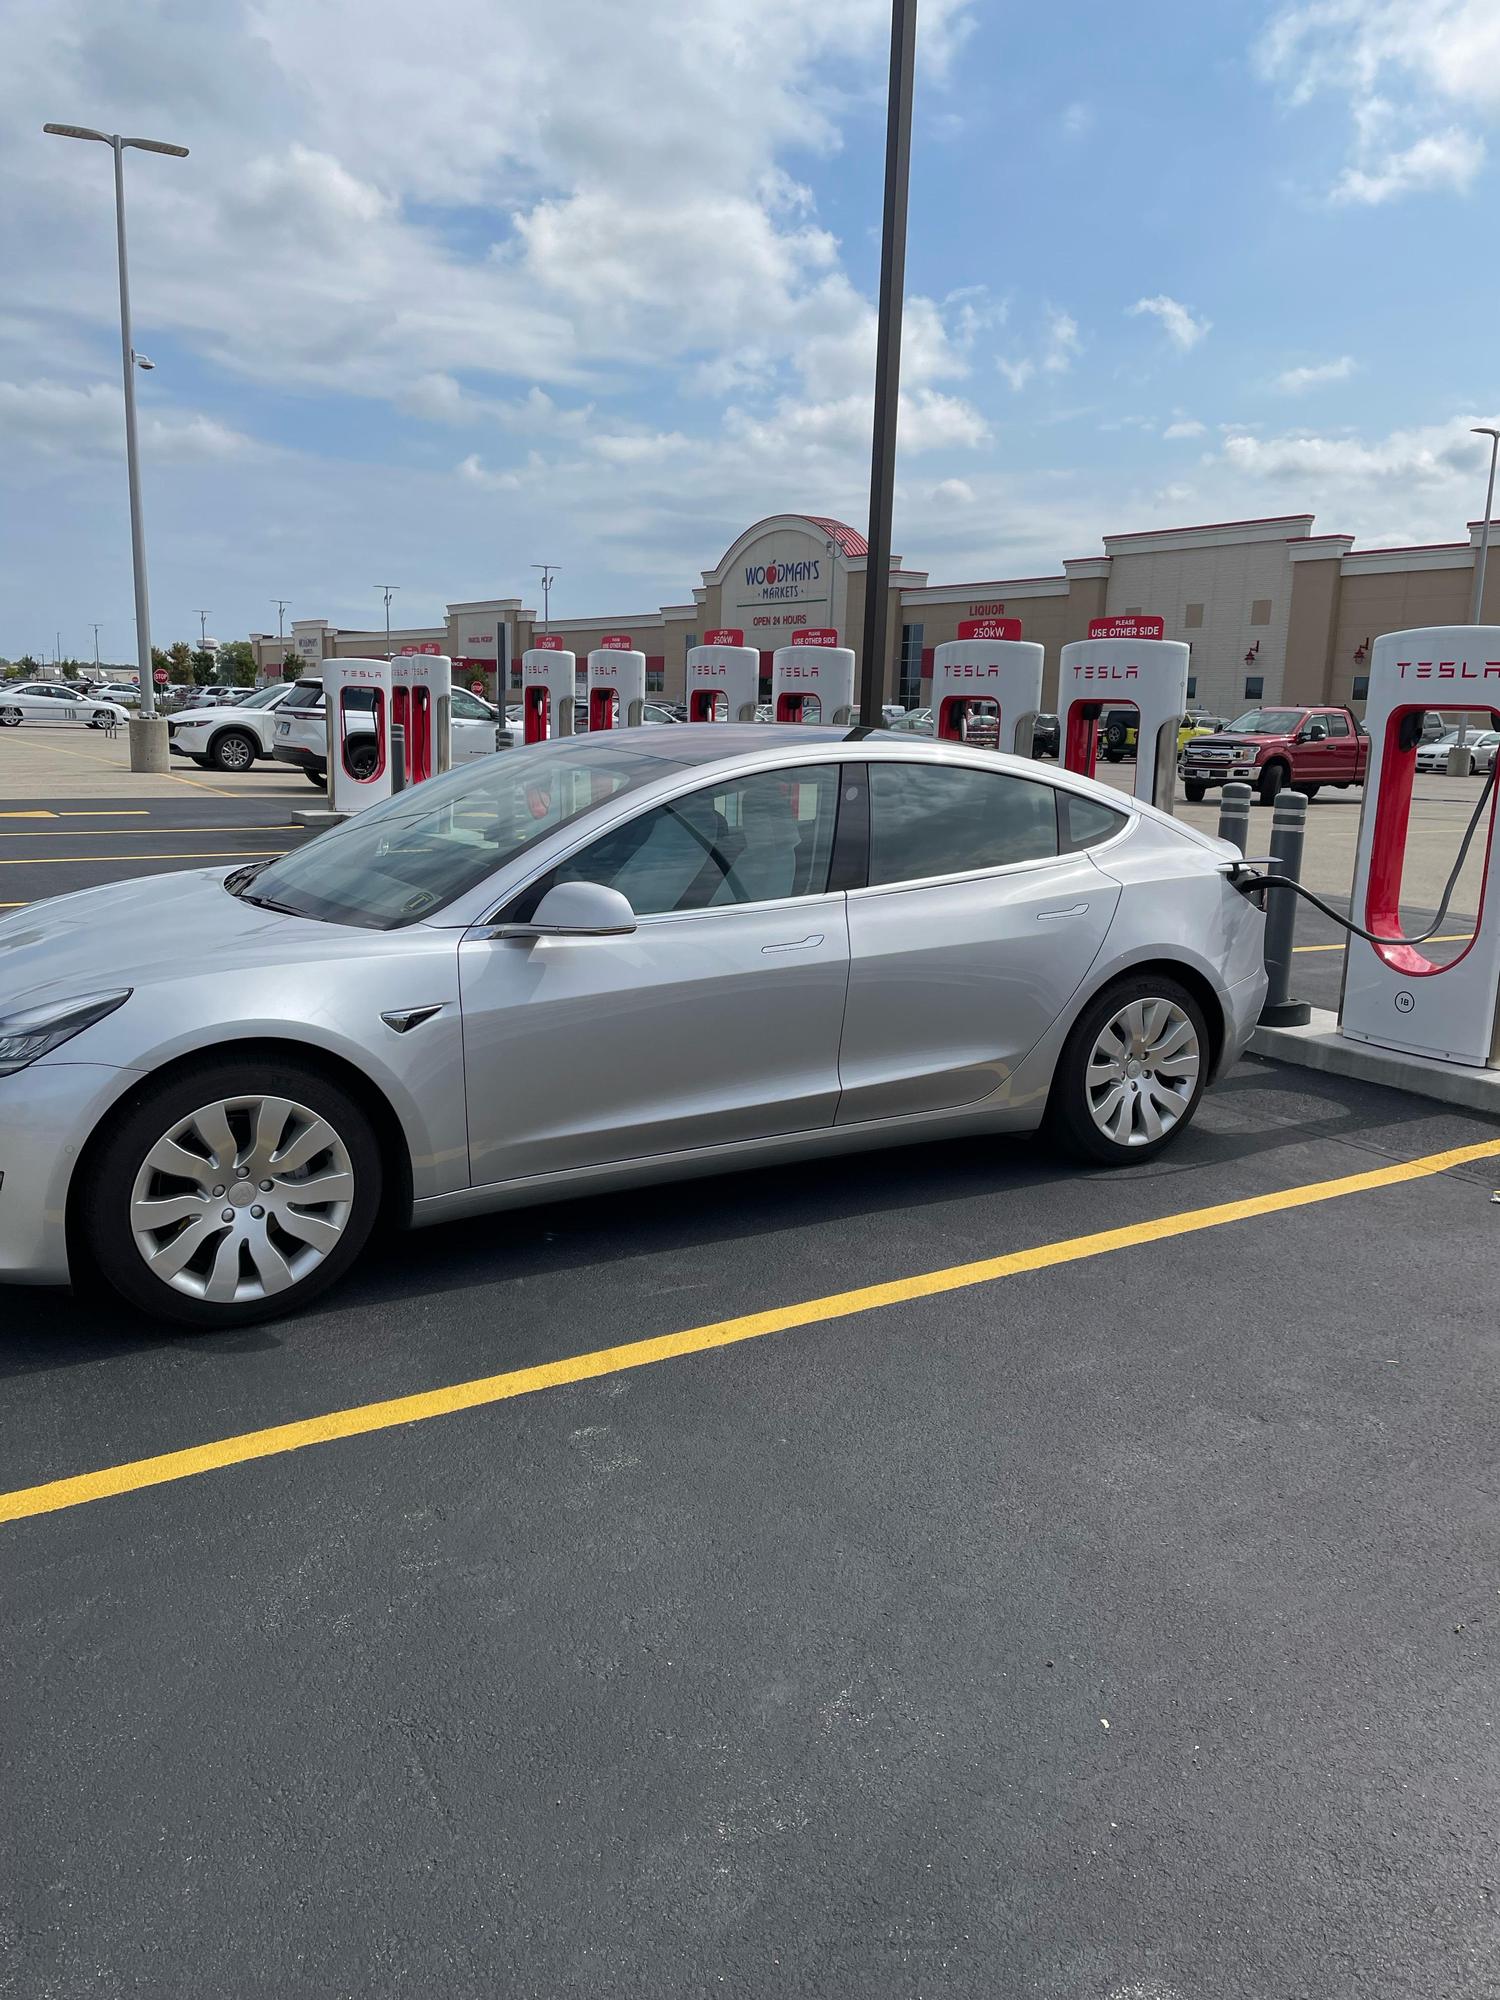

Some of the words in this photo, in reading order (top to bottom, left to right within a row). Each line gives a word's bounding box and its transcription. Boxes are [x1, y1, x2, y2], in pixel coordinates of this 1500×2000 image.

[745, 559, 820, 586] WOODMAN'S
[762, 585, 799, 599] MARKETS
[969, 604, 1005, 616] LIQUOR
[753, 616, 771, 626] OPEN
[772, 616, 781, 625] 24
[782, 614, 807, 625] HOURS
[973, 626, 1005, 638] 250kW
[1091, 628, 1108, 638] USE
[1109, 627, 1138, 637] OTHER
[1139, 626, 1160, 636] SIDE
[713, 636, 734, 645] 250kW
[341, 669, 382, 678] TESLA
[525, 665, 549, 674] TESLA
[591, 666, 617, 675] TESLA
[691, 665, 726, 676] TESLA
[779, 666, 819, 678] TESLA
[943, 664, 999, 678] TESLA
[1073, 665, 1139, 679] TESLA
[1396, 661, 1500, 679] TESLA
